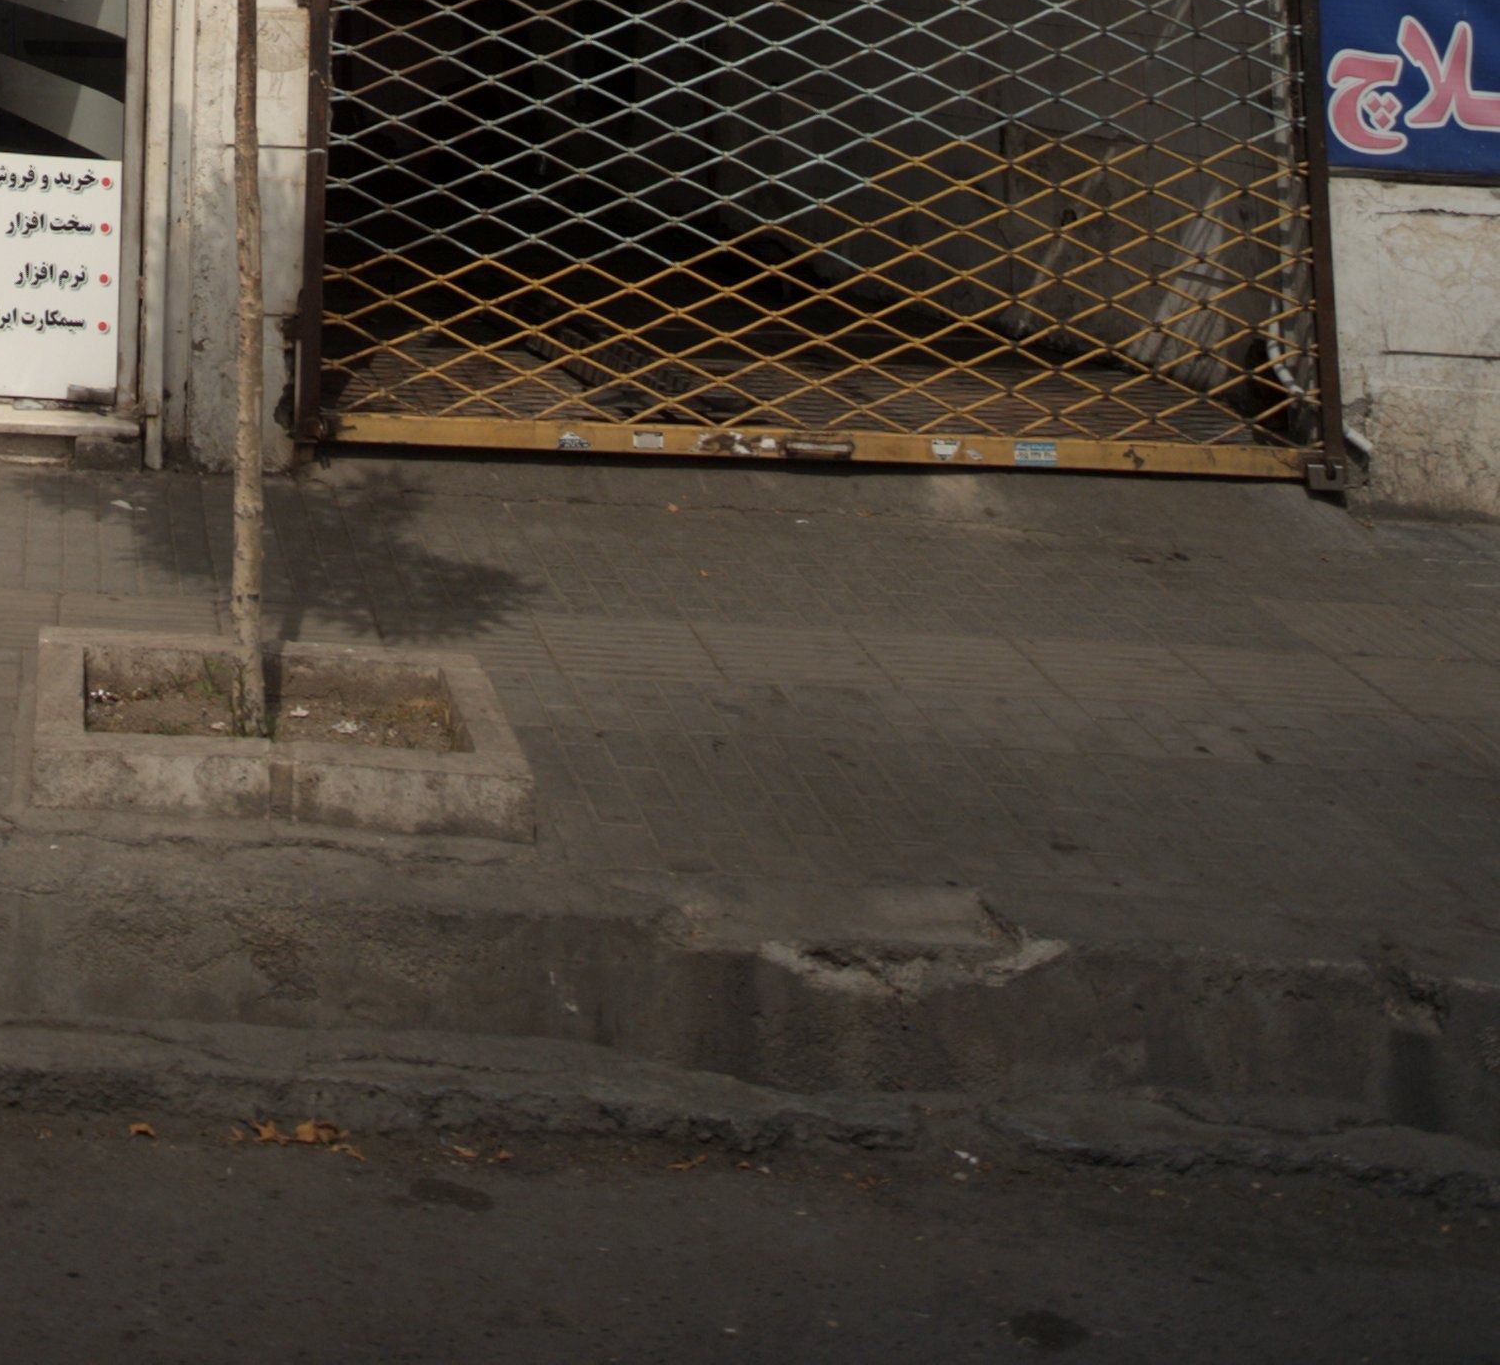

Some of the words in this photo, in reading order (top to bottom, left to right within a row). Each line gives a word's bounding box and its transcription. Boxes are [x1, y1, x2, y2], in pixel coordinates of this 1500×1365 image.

[1327, 15, 1500, 156] لاچ
[41, 174, 49, 190] و
[54, 170, 97, 191] خرید
[5, 212, 46, 236] افزار
[49, 215, 93, 233] سخت
[14, 263, 54, 286] افزار
[58, 265, 86, 289] نرم
[21, 310, 85, 333] سیمکارت
